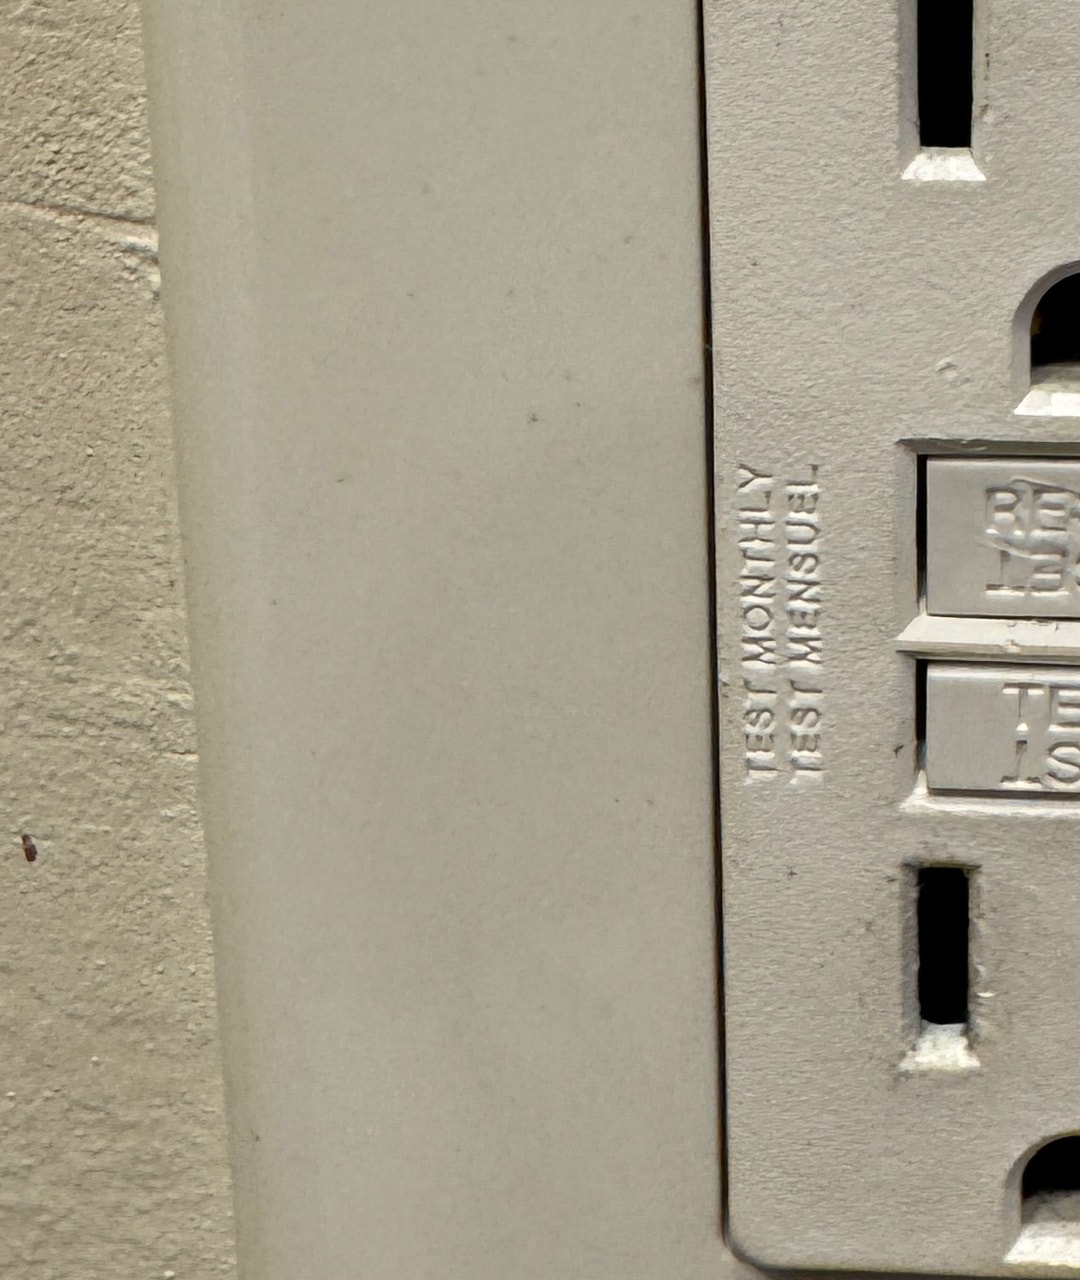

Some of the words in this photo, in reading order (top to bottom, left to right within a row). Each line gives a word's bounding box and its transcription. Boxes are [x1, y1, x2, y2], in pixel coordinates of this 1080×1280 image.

[737, 462, 777, 670] MONTHLY
[785, 462, 824, 670] MENSUEL
[742, 677, 778, 785] TEST
[788, 679, 824, 785] TEST
